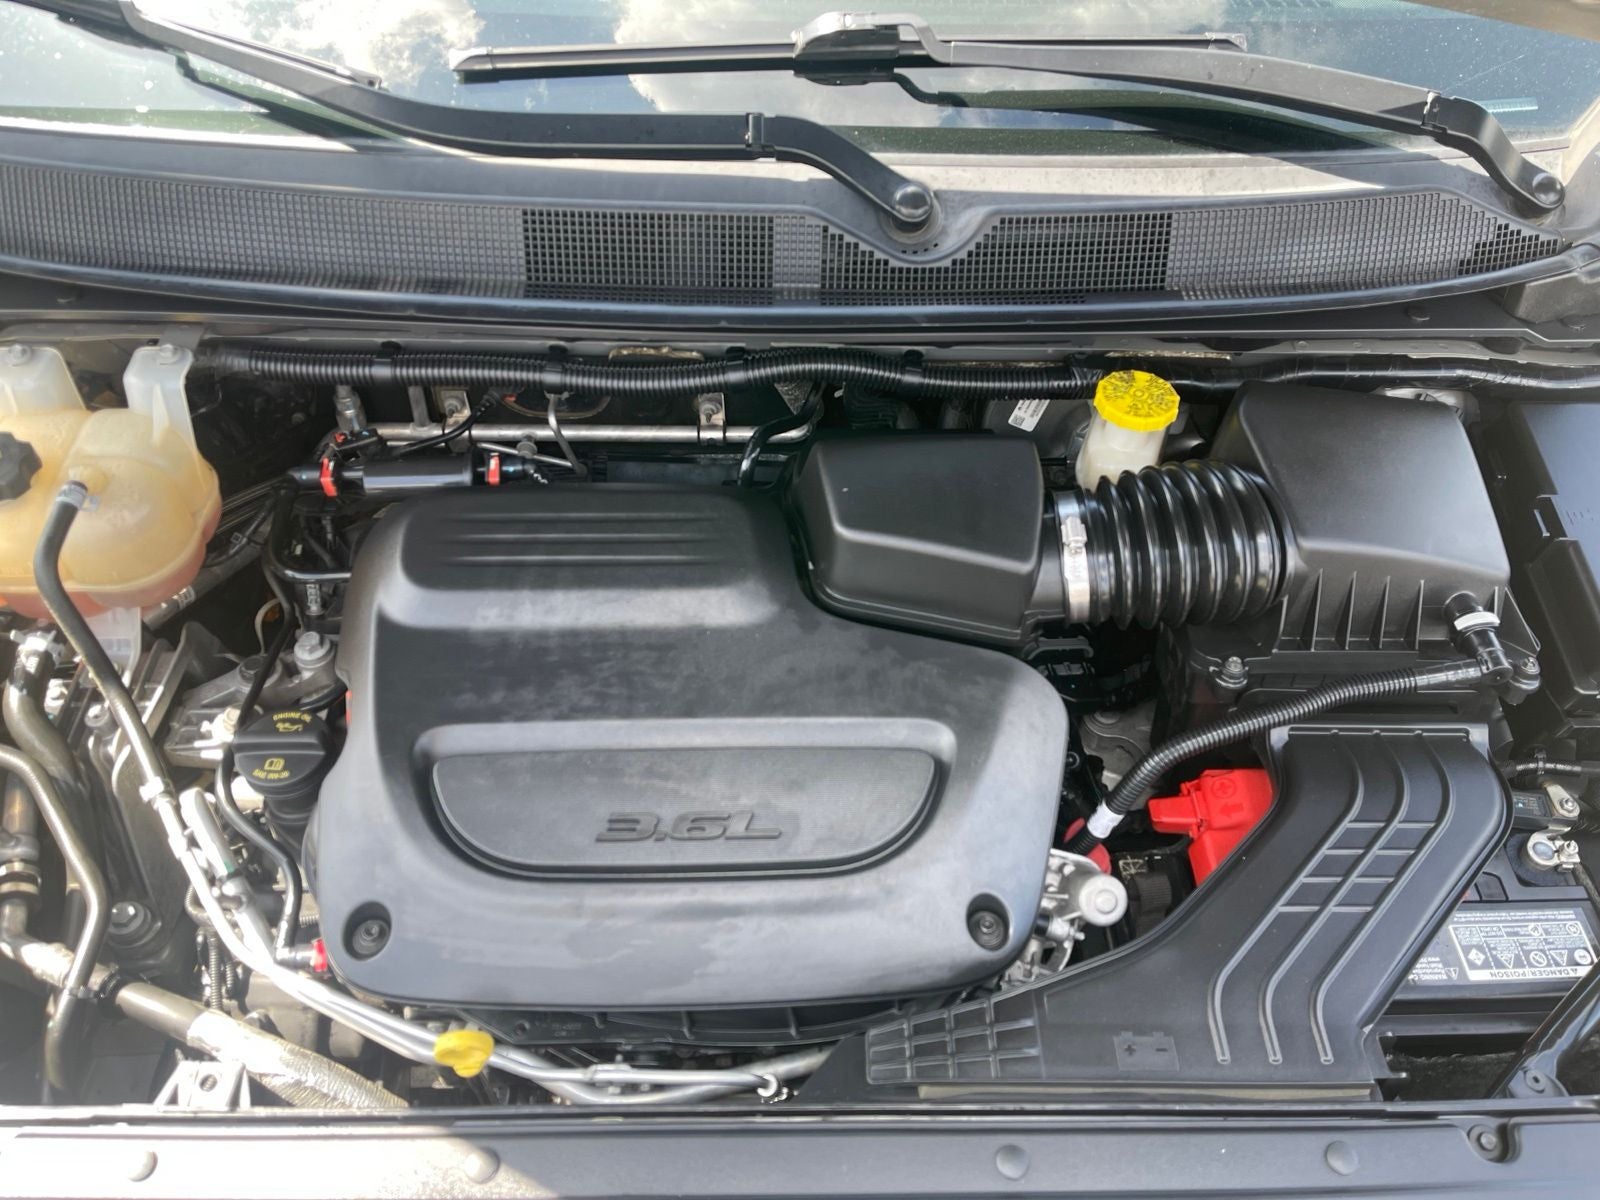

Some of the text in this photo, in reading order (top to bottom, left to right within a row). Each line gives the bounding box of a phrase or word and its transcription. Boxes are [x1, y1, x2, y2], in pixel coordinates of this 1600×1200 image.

[272, 712, 312, 723] ENGINE OIL
[595, 811, 782, 842] 3.6L
[1489, 968, 1570, 978] DANGER/POISON
